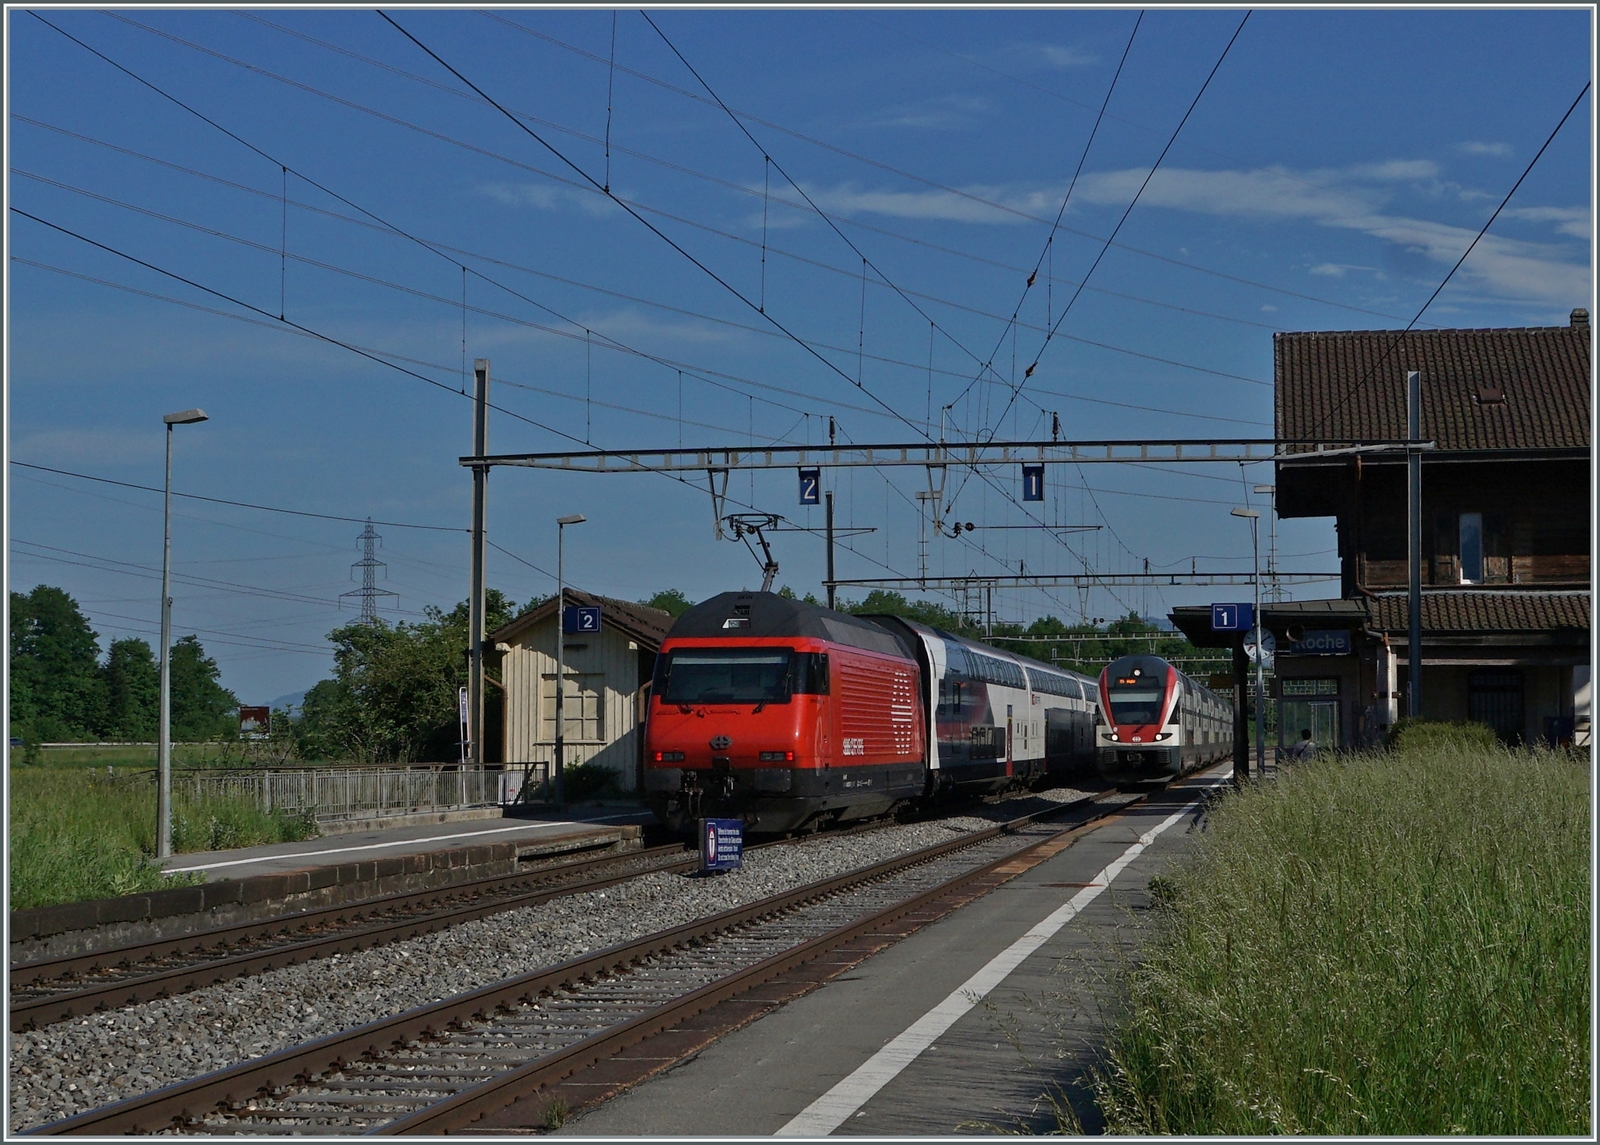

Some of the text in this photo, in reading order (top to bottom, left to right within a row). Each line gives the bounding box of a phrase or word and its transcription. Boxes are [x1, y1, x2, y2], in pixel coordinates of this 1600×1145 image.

[804, 476, 816, 499] 2
[1029, 472, 1036, 496] 1
[583, 614, 593, 628] 2
[1221, 611, 1228, 626] 1
